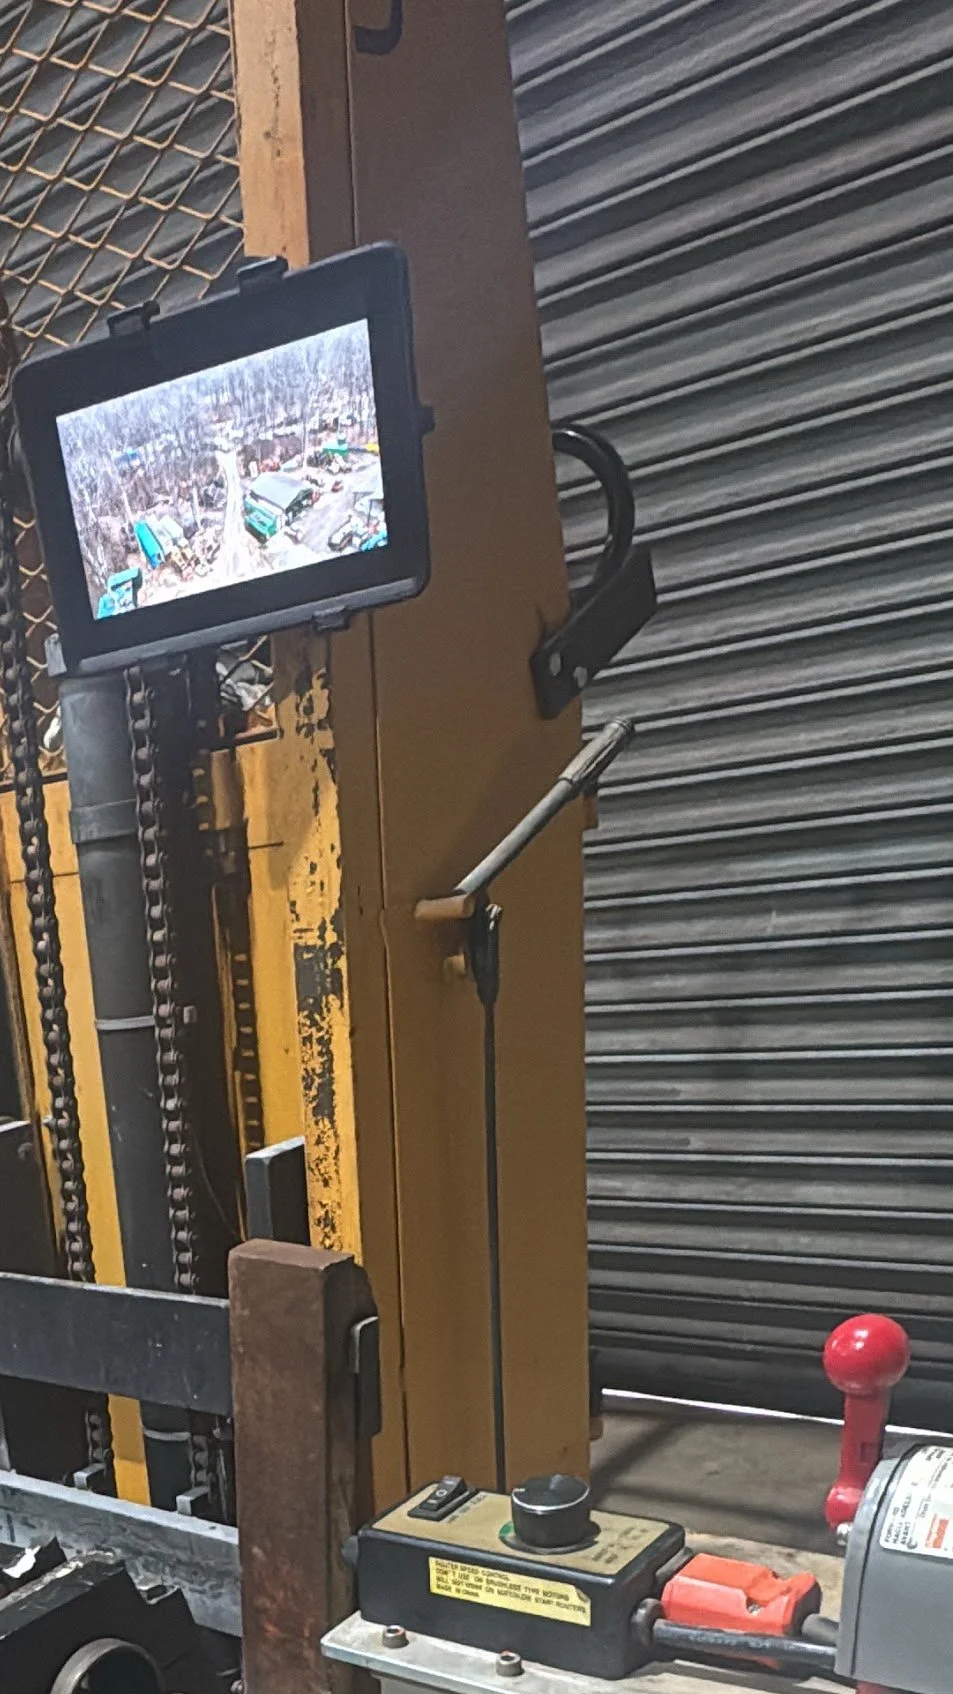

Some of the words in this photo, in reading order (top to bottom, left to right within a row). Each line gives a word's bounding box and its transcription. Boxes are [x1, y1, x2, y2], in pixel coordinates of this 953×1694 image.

[435, 1560, 458, 1571] ROUTER
[460, 1565, 480, 1575] SPEED
[451, 1578, 464, 1587] NOT
[459, 1571, 470, 1581] USE
[474, 1575, 484, 1583] ON
[524, 1586, 540, 1595] TYPE
